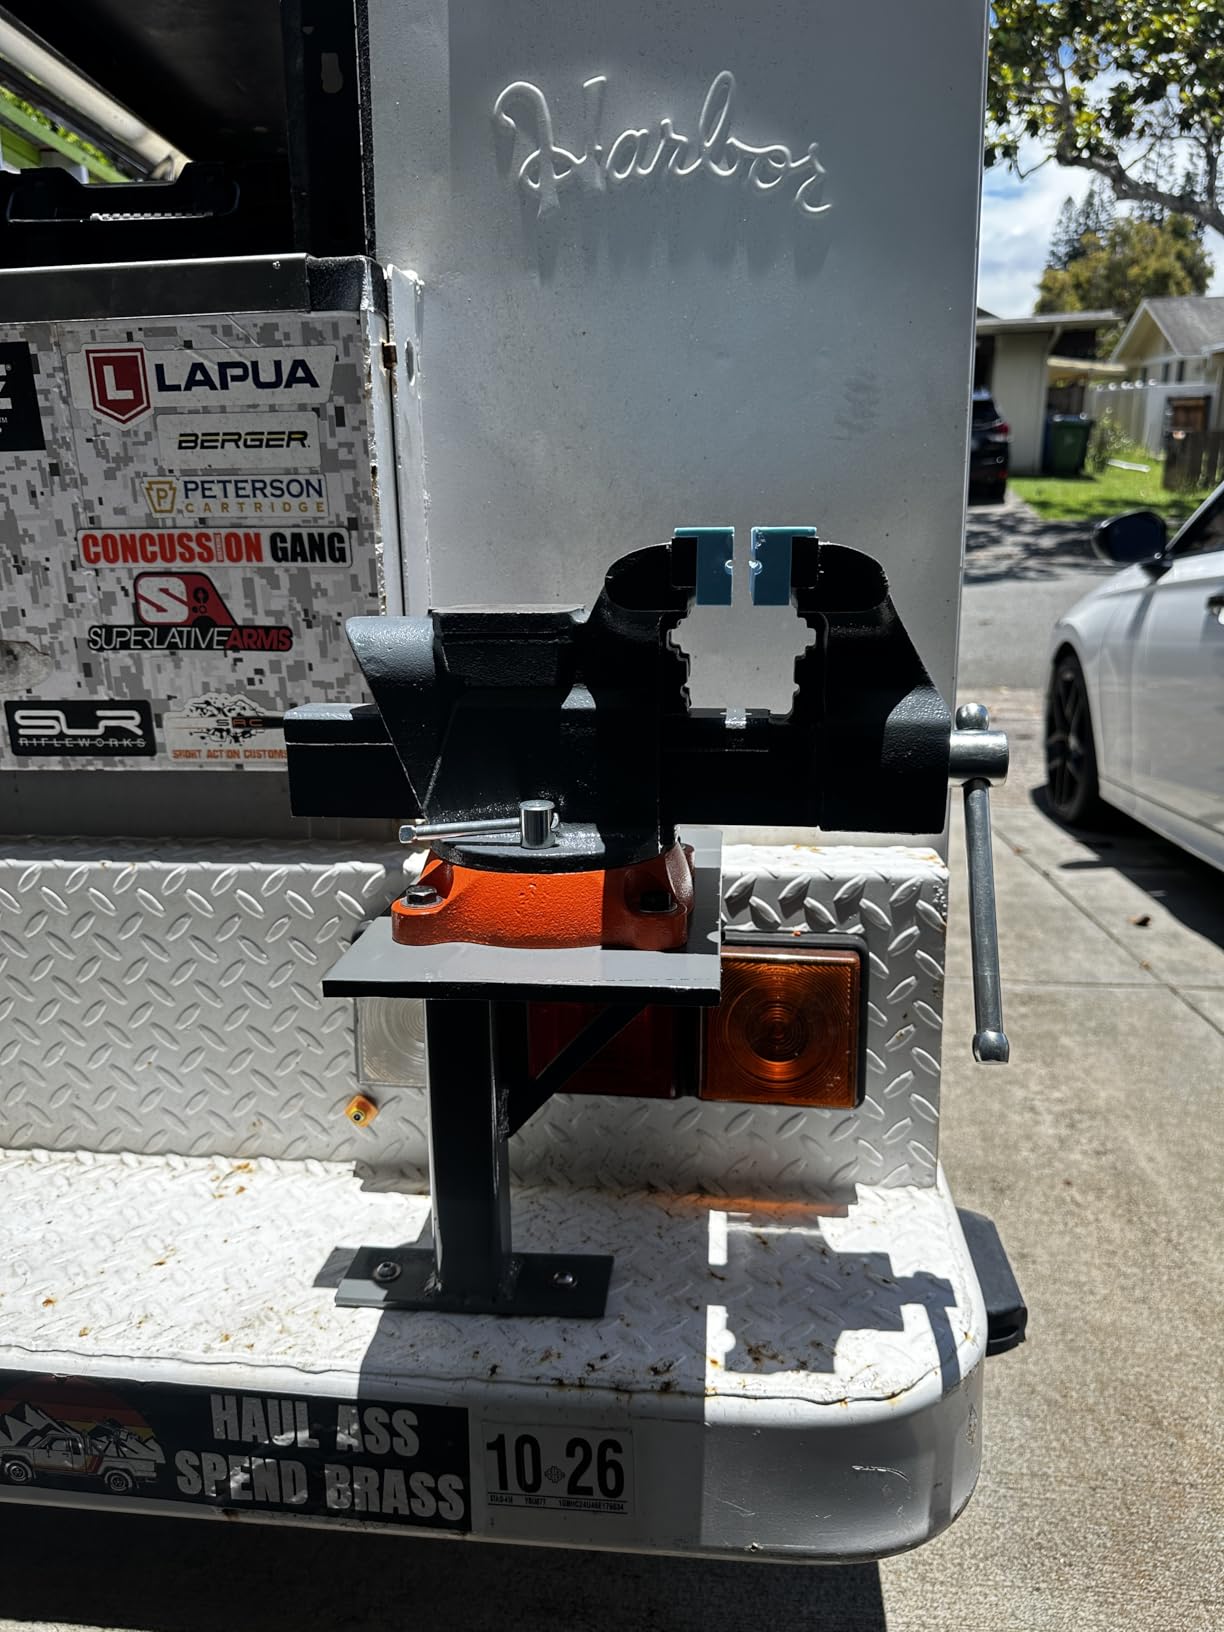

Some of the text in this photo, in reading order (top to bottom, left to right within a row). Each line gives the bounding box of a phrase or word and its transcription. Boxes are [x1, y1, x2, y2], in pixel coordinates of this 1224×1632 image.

[155, 359, 320, 392] LAPUA
[184, 478, 323, 499] PETERSON
[185, 502, 325, 513] CARTRIDGE
[81, 532, 347, 564] CONCUSSION GANG
[14, 710, 143, 736] SLR
[18, 738, 146, 748] RIFLEWORKS
[211, 1394, 420, 1457] HAUL ASS
[486, 1433, 625, 1498] 10 26
[175, 1450, 466, 1521] SPEND BRASS
